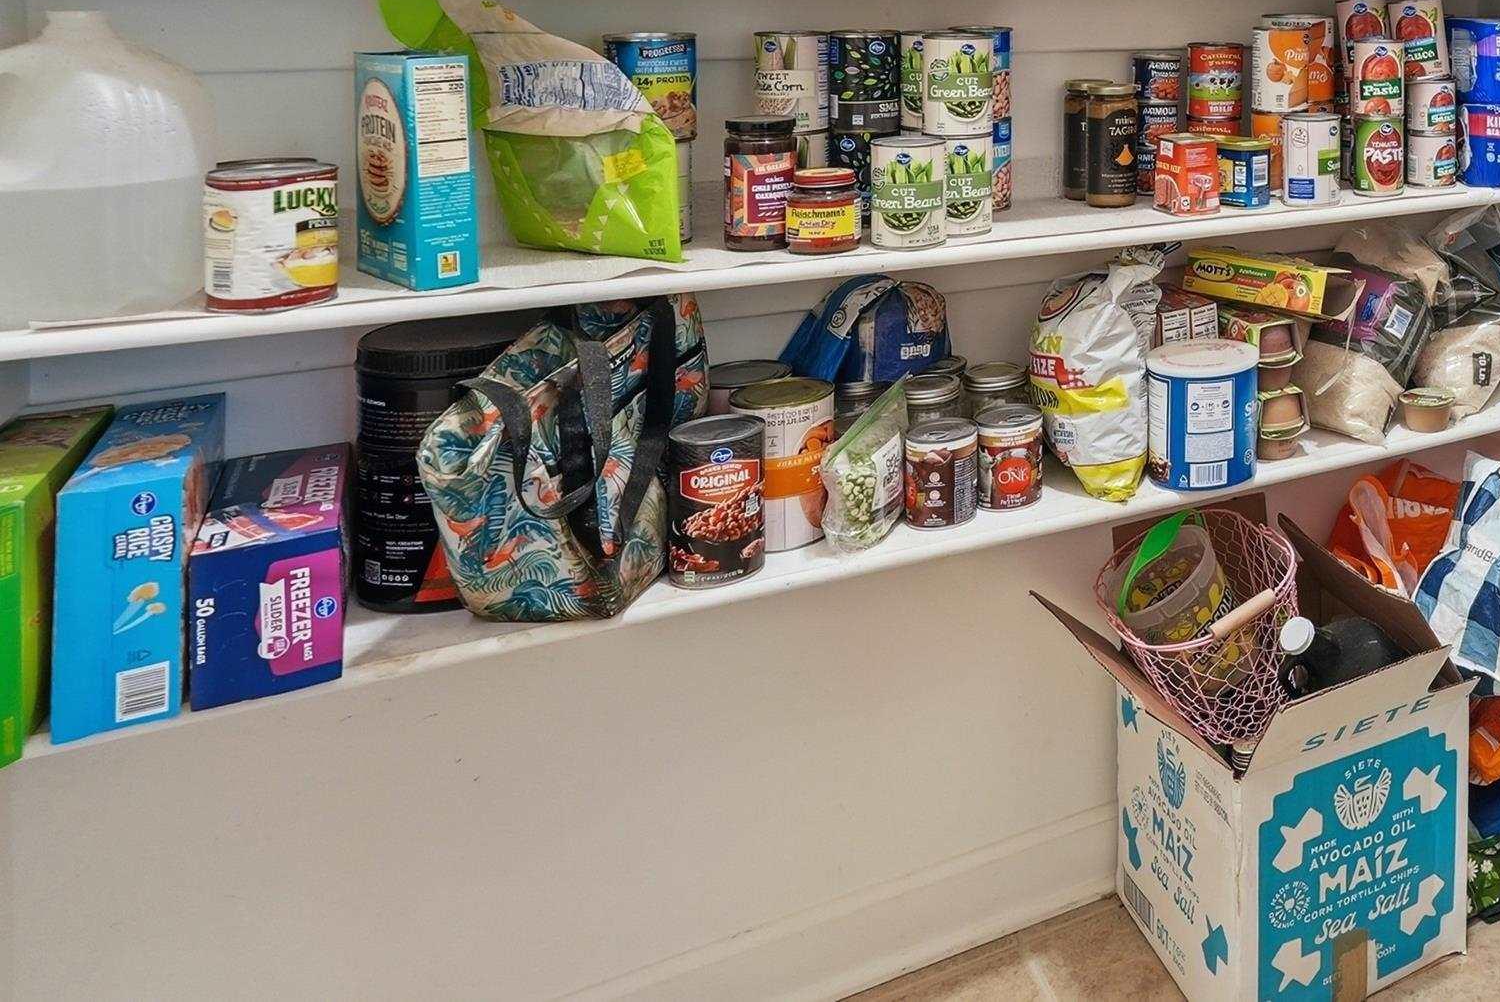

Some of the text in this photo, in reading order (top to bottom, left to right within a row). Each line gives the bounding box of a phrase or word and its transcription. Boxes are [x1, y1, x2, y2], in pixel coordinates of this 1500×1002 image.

[774, 81, 804, 91] Corn
[957, 77, 978, 86] CUT
[930, 86, 966, 98] Green
[892, 187, 916, 196] CUT
[906, 196, 942, 208] Beans
[1196, 262, 1233, 278] MOTT'S
[689, 470, 752, 489] ORIGINAL
[128, 528, 149, 559] RICE
[150, 515, 172, 562] CRISPY
[195, 597, 214, 617] 50
[269, 595, 283, 633] SLIDER
[289, 567, 312, 643] FREEZER
[1301, 693, 1436, 753] SIETE
[1344, 757, 1382, 778] SIETE
[1309, 819, 1416, 871] AVOCADO OIL
[1310, 838, 1338, 854] MADE
[1304, 864, 1420, 923] CORN TORTILLA CHIPS
